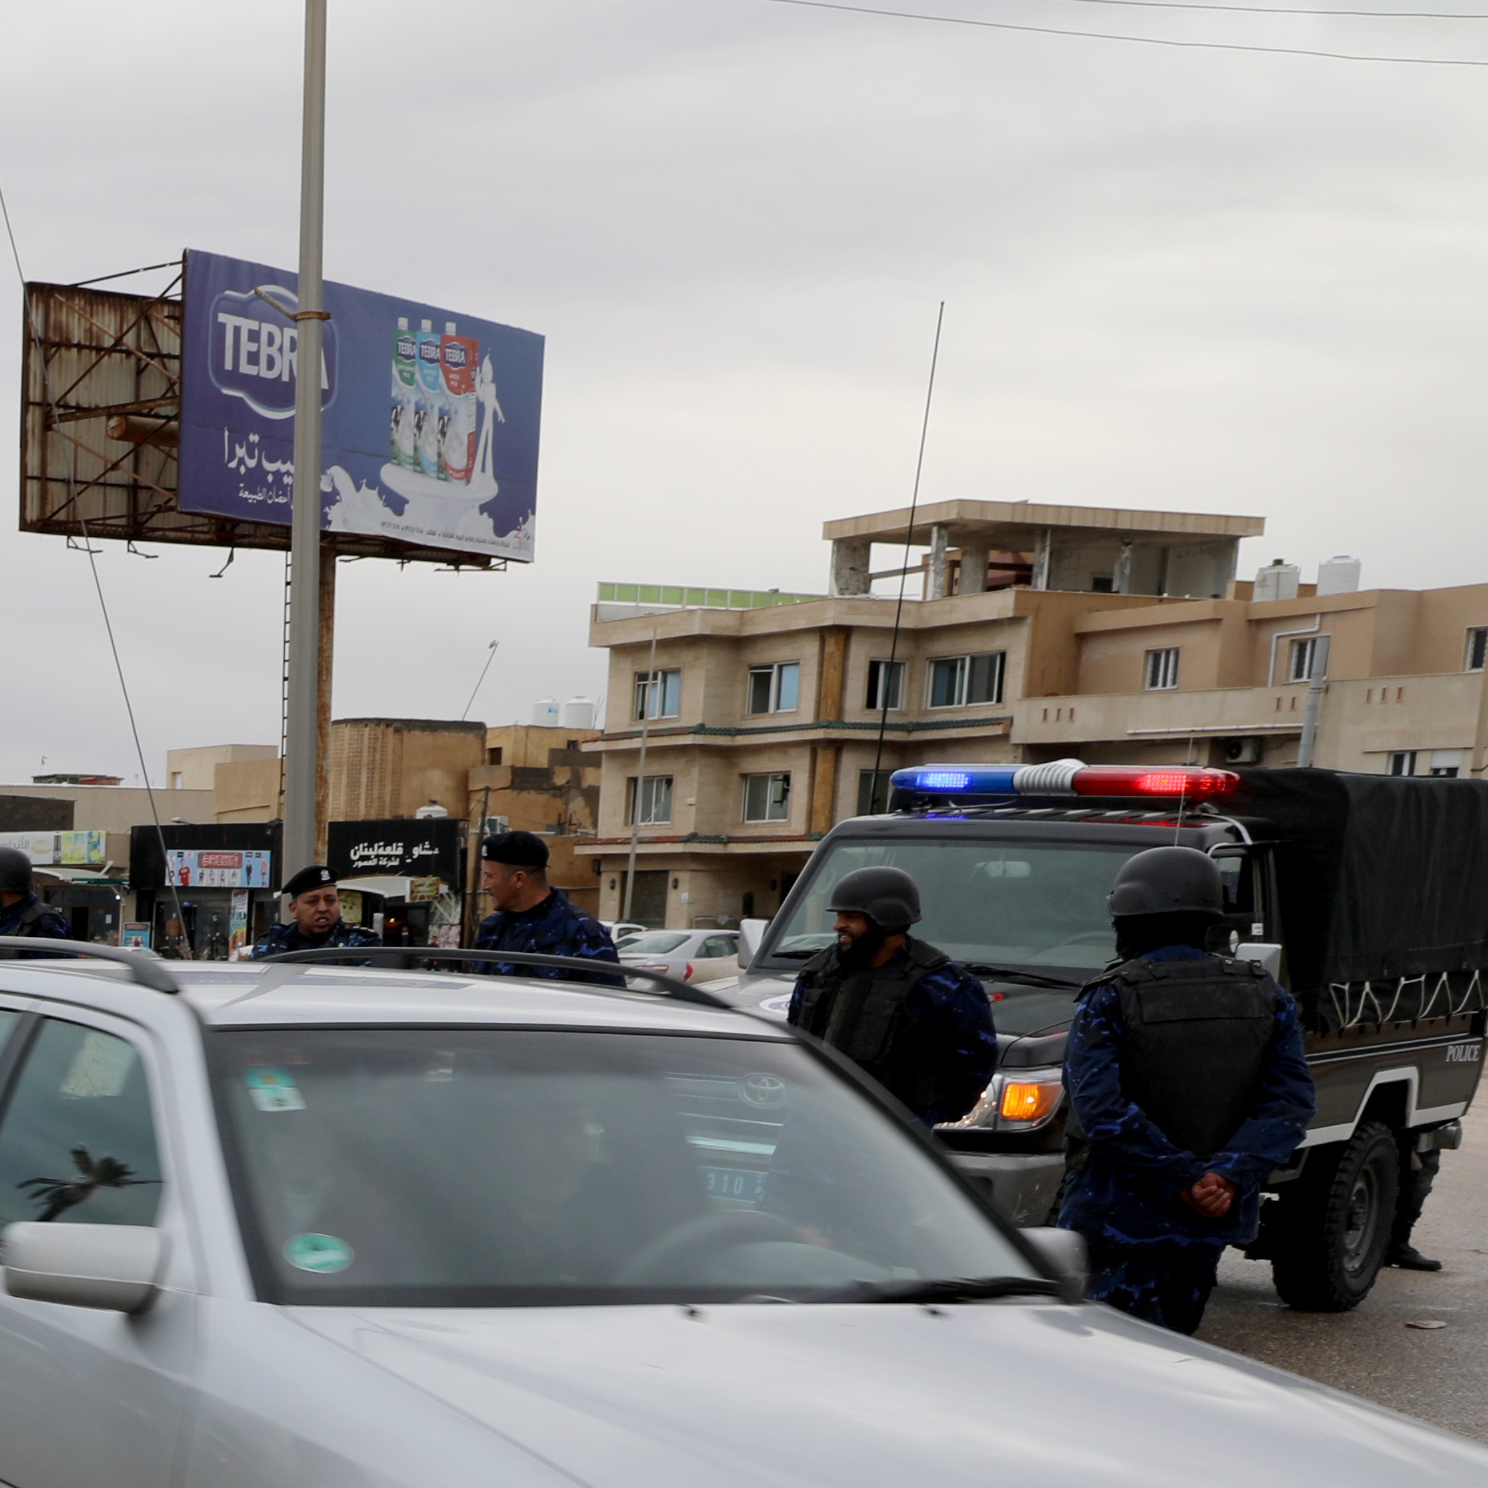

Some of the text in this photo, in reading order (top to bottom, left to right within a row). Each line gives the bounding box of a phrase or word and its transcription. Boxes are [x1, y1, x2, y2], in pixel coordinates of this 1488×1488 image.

[217, 312, 329, 390] TEBR
[224, 426, 260, 475] تبرا
[350, 842, 379, 860] لبنان
[378, 841, 404, 856] قلعة
[1445, 1044, 1481, 1062] POLICE
